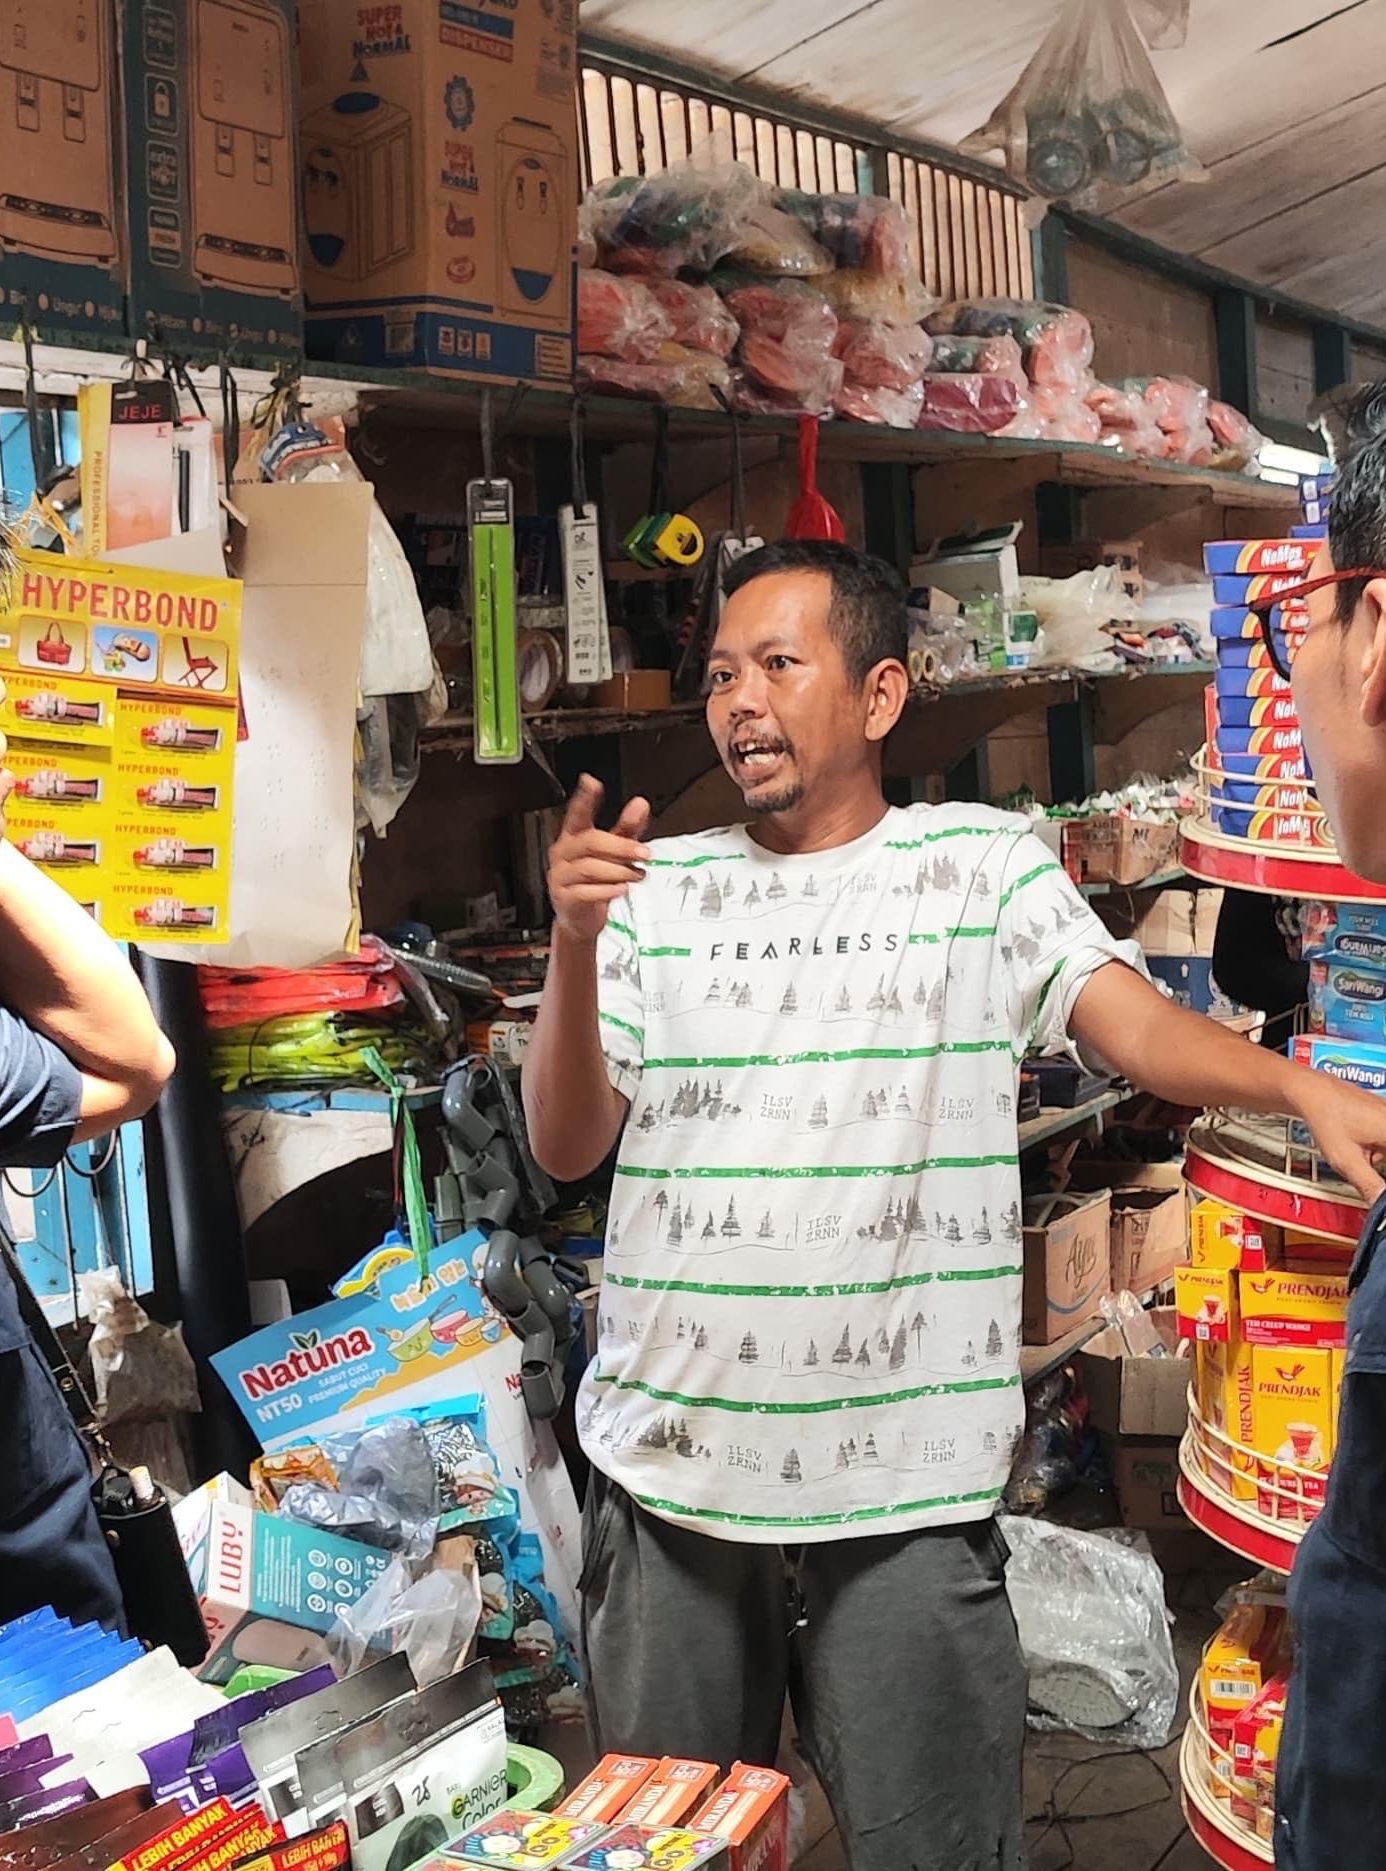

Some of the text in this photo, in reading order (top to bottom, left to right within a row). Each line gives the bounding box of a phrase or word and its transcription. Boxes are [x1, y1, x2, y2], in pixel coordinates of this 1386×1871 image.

[353, 36, 411, 58] NORMAL
[118, 404, 163, 420] JEJE
[90, 449, 103, 535] PROFESSIONAL
[21, 572, 219, 632] HYPERBOND
[4, 676, 58, 691] YPERBOND
[120, 703, 182, 716] HYPERBOND
[1, 756, 58, 769] YPERBOND
[117, 763, 179, 776] HYPERBOND
[4, 818, 56, 830] PERBOND
[115, 824, 177, 836] HYPERBOND
[113, 885, 175, 897] HYPERBOND
[709, 932, 899, 961] FEARLESS
[1337, 977, 1385, 996] SariWangi
[1323, 1062, 1386, 1087] SariWangi
[762, 1093, 793, 1108] ILSV
[940, 1097, 974, 1110] ILSV
[760, 1106, 791, 1121] ZRNN
[938, 1108, 974, 1121] ZRNN
[808, 1214, 842, 1229] ILSV
[805, 1226, 842, 1244] ZRNN
[241, 1328, 373, 1398] Natuna
[318, 1363, 370, 1388] SABUT CUCI
[308, 1367, 387, 1404] PREMIUM QUALITY
[1258, 1382, 1322, 1398] PRENDJAK
[256, 1394, 303, 1423] NT50
[1240, 1363, 1254, 1445] PRENDJAK
[727, 1444, 762, 1460] ILSV
[923, 1437, 957, 1452] ILSV
[726, 1455, 762, 1473] ZRNN
[922, 1449, 957, 1463] ZRNN
[219, 1520, 245, 1595] LUBY
[461, 1796, 502, 1831] Color
[131, 1841, 173, 1871] LEBIH
[172, 1804, 228, 1846] BANYAK
[281, 1841, 312, 1868] LEBIH
